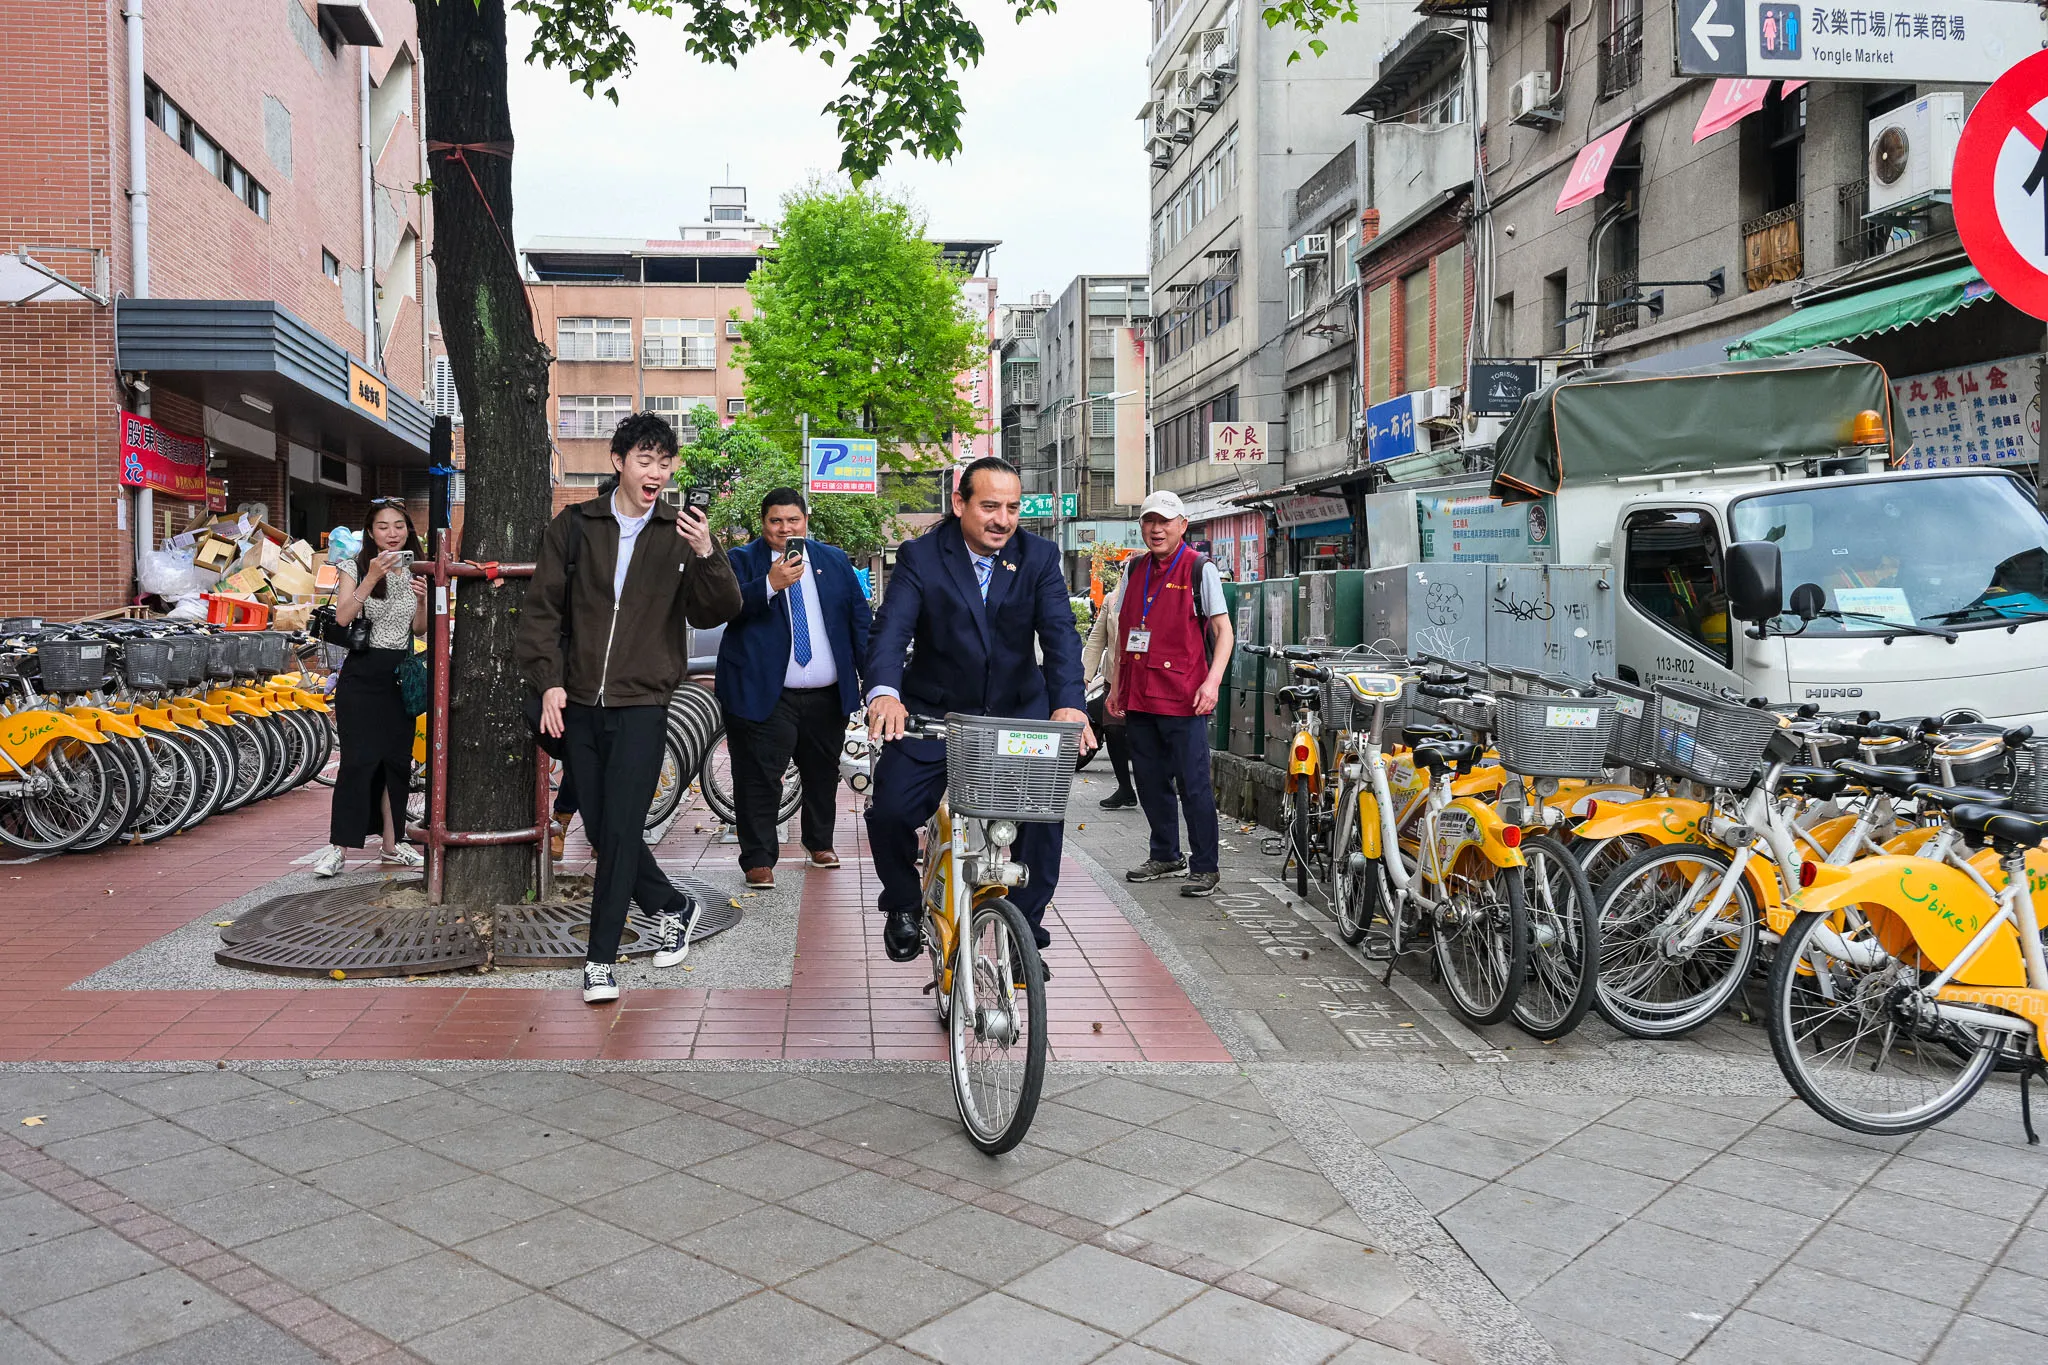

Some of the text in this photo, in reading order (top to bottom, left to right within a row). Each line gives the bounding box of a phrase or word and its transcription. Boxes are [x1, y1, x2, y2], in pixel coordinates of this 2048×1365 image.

[1812, 8, 1965, 41] 永樂市場/布業商場
[1812, 47, 1894, 64] Yongle Market
[1491, 371, 1519, 381] TORISUN
[1219, 425, 1259, 446] 介良
[1368, 411, 1412, 449] 中一布行
[851, 455, 873, 464] 24H
[1215, 448, 1264, 461] 裡布行
[1656, 656, 1695, 673] 113-R02
[1805, 688, 1863, 698] HINO
